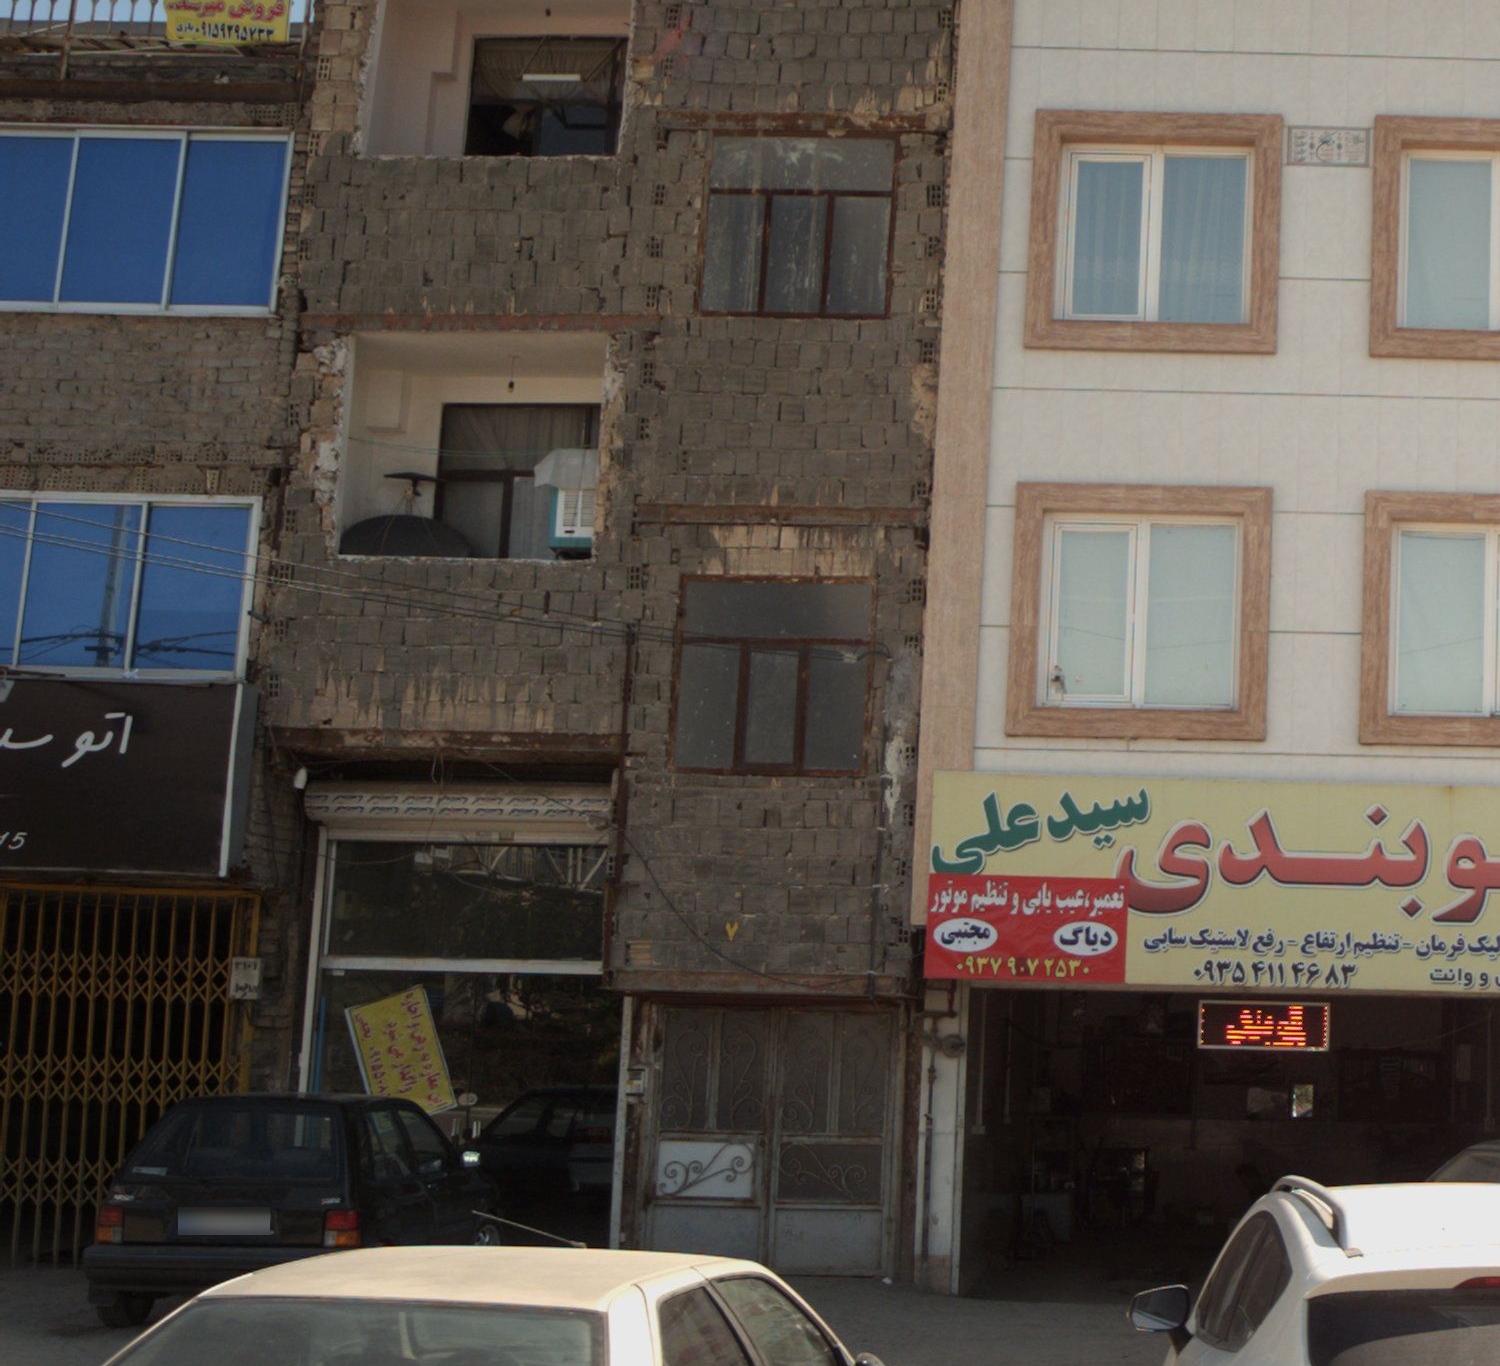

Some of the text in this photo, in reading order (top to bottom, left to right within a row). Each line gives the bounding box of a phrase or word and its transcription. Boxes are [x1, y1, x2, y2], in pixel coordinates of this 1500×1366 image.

[61, 711, 133, 768] اتو
[932, 787, 1150, 875] سید علی
[930, 881, 968, 913] موتور
[971, 880, 1008, 912] تنظیم
[1010, 892, 1019, 915] و
[941, 921, 991, 945] مجتبی
[1060, 925, 1112, 952] دیاگ
[1190, 928, 1251, 951] لاستیک
[1252, 928, 1284, 954] رفع
[1301, 932, 1351, 956] ارتفاع
[1354, 932, 1399, 956] تنظیم
[1416, 934, 1466, 958] فرمان
[1430, 968, 1472, 988] وانت
[1479, 972, 1489, 988] و
